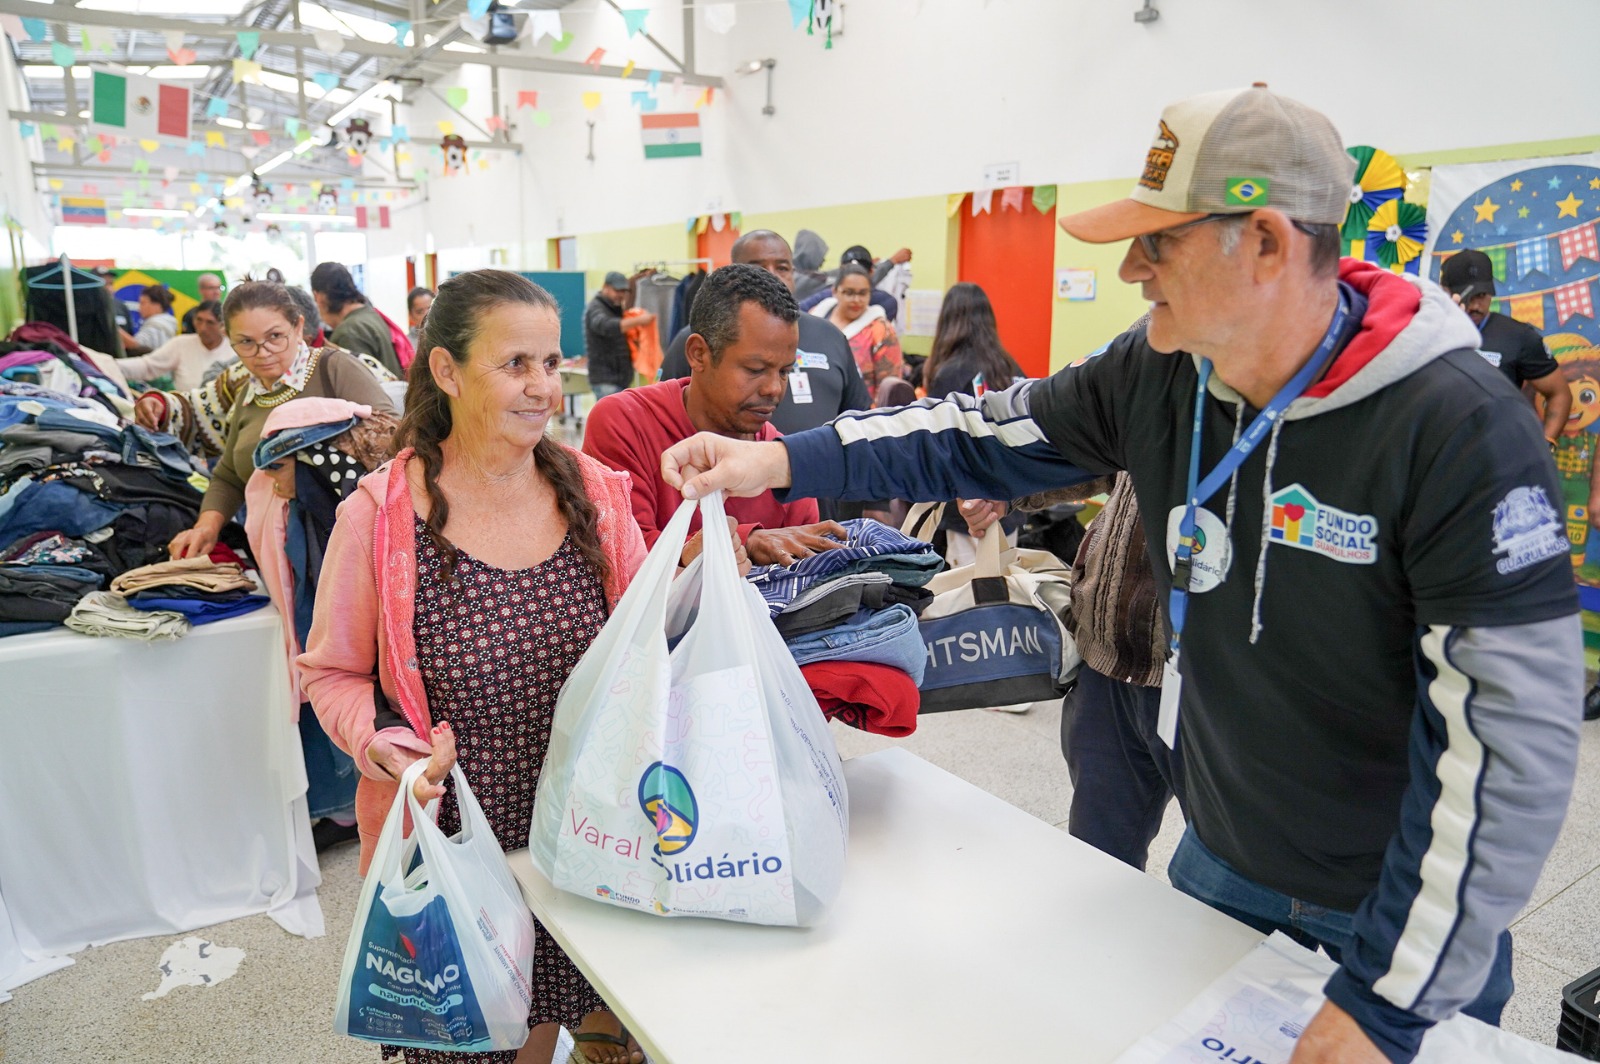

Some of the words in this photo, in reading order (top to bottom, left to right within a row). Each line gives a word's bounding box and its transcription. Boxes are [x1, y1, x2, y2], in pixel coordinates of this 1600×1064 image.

[1317, 509, 1372, 535] FUNDO
[1314, 540, 1370, 560] GUARULHOS
[1315, 526, 1371, 550] SOCIAL
[1498, 537, 1568, 572] GUARULHOS
[571, 808, 642, 860] Varal
[391, 1013, 404, 1021] ON
[1201, 1037, 1267, 1064] rio
